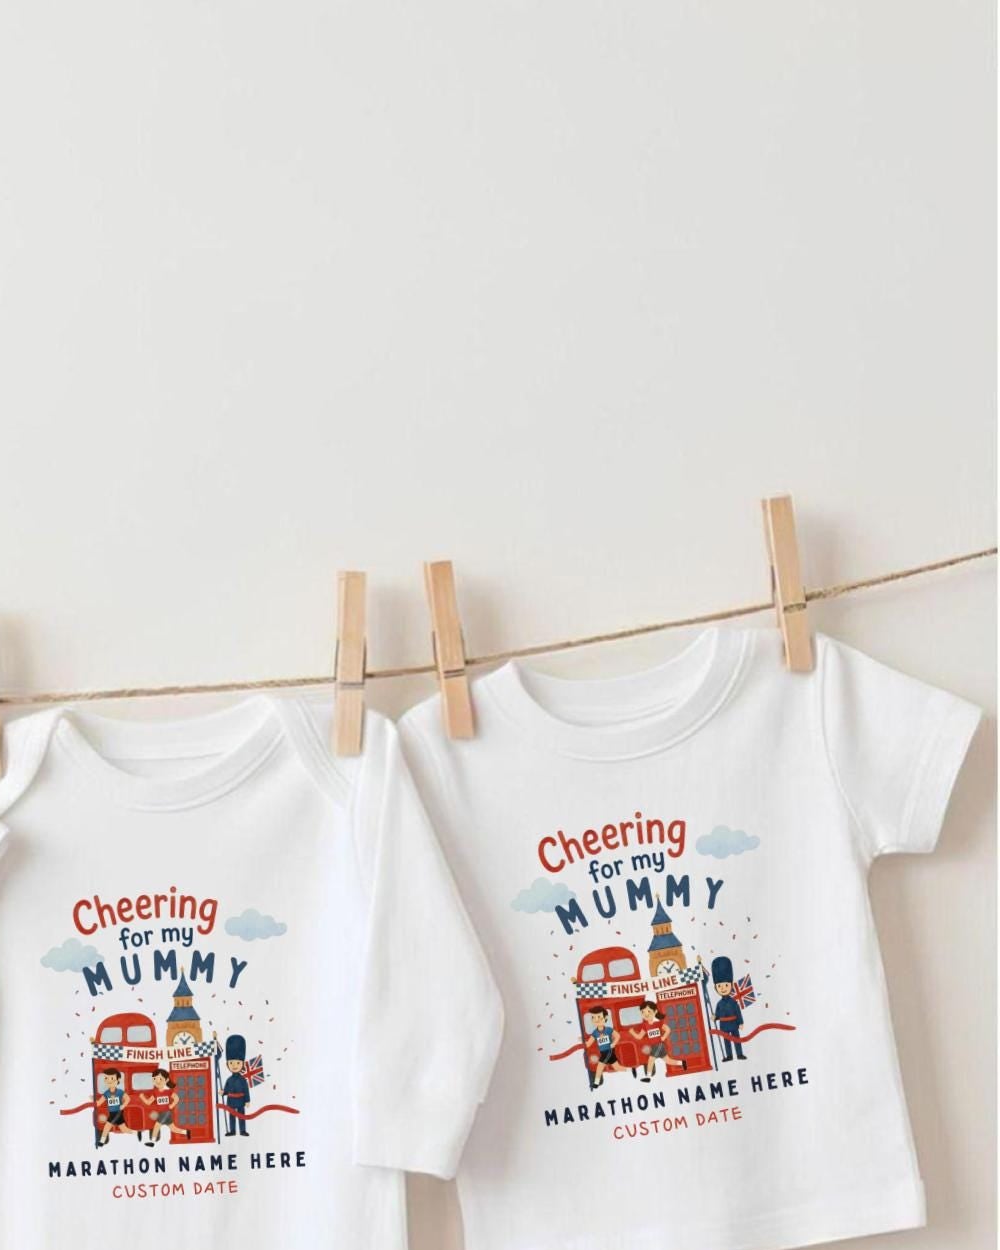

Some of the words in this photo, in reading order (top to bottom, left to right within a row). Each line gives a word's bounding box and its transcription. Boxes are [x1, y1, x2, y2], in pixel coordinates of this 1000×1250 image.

[538, 812, 686, 873] Cheering
[589, 860, 623, 883] for
[632, 852, 665, 873] my
[73, 886, 218, 935] Cheering
[555, 875, 724, 935] MUMMY
[119, 927, 153, 949] for
[162, 926, 193, 946] my
[82, 949, 247, 996] MUMMY
[611, 982, 649, 994] FINISH
[653, 976, 678, 990] LINE
[660, 990, 695, 999] TELEPHONE
[127, 1050, 163, 1059] FINISH
[167, 1047, 192, 1058] LINE
[545, 1092, 666, 1126] MARATHON
[678, 1080, 739, 1105] NAME
[751, 1068, 809, 1093] HERE
[614, 1116, 688, 1139] CUSTOM
[696, 1106, 742, 1125] DATE
[49, 1158, 165, 1177] MARATHON
[179, 1154, 237, 1172] NAME
[251, 1152, 306, 1169] HERE
[112, 1184, 184, 1199] CUSTOM
[194, 1181, 238, 1195] DATE
